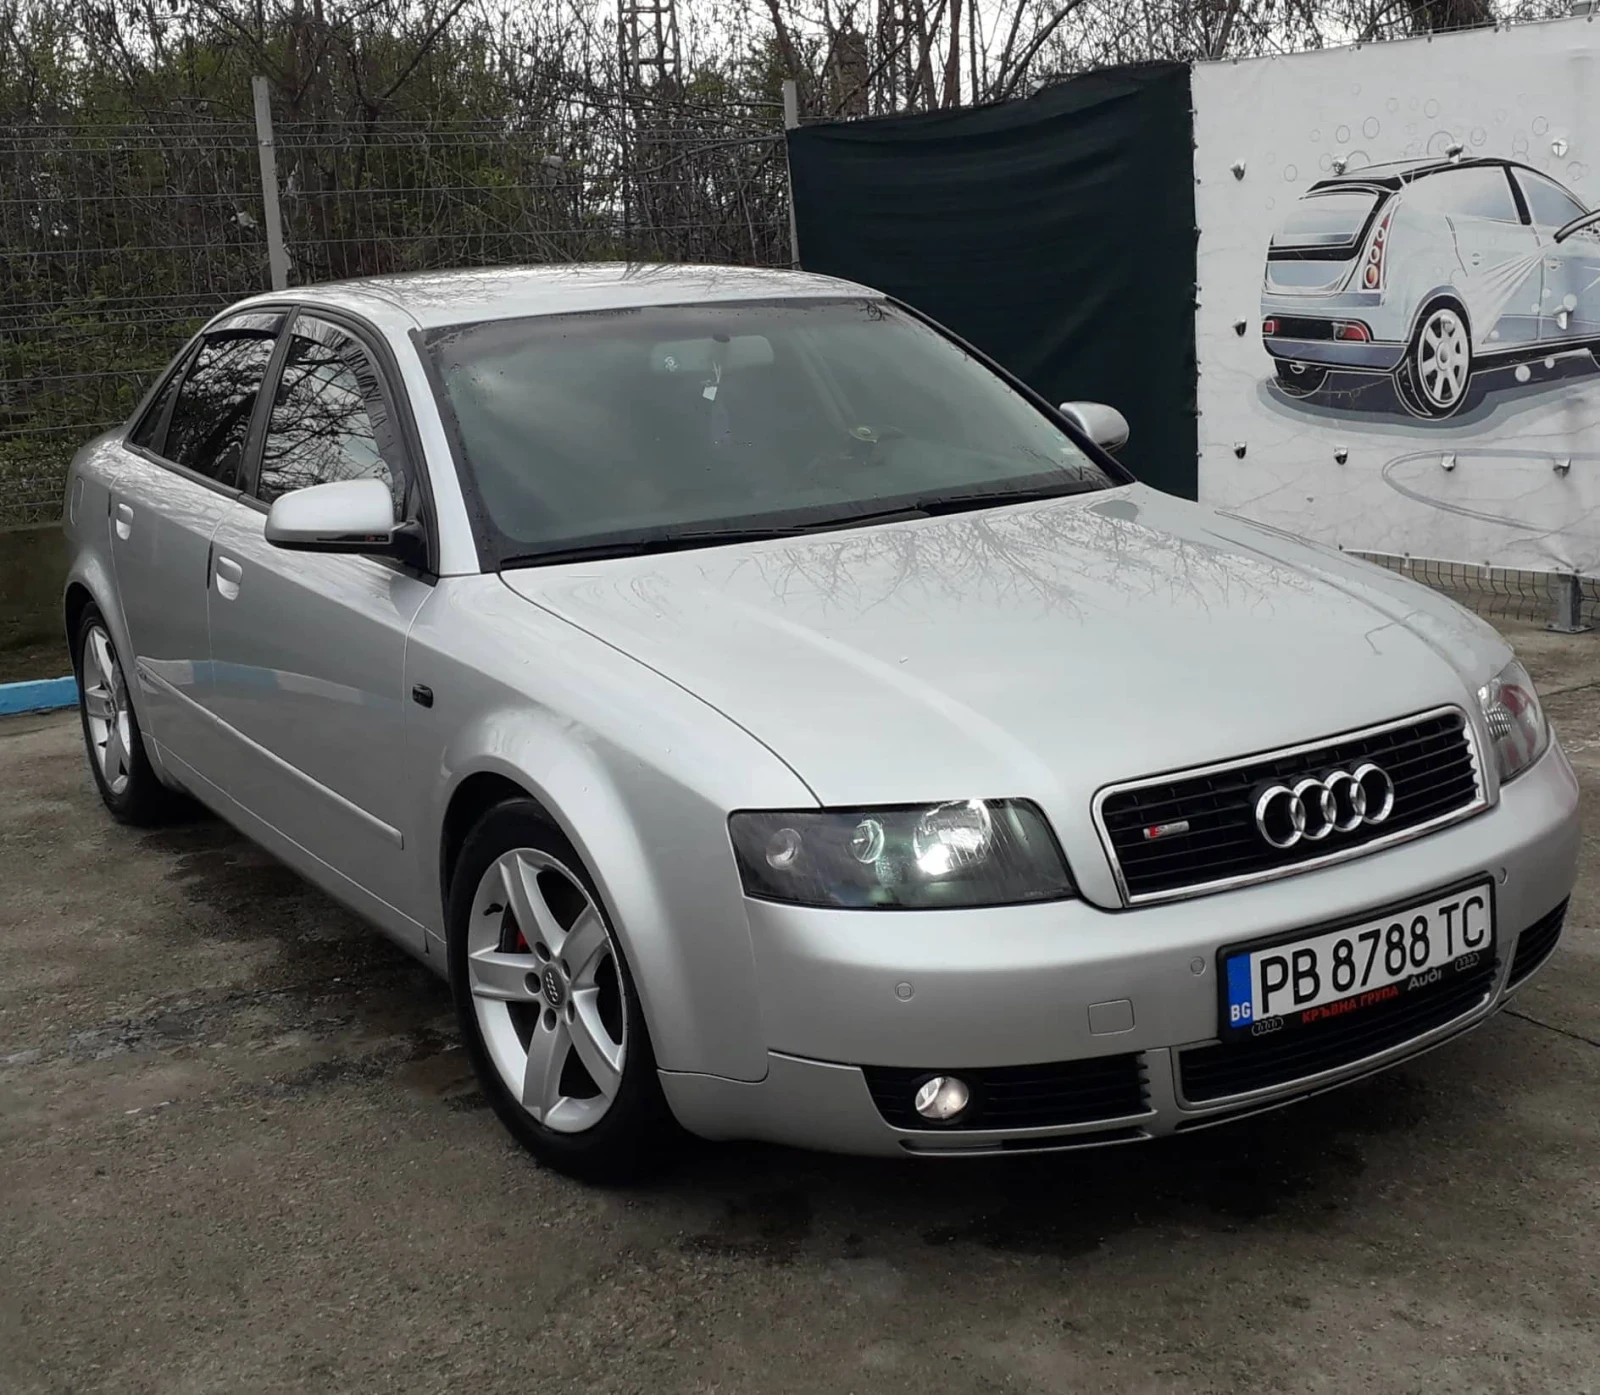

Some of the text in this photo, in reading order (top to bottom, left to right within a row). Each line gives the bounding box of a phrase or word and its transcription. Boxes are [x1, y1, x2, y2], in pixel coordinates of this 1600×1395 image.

[1260, 896, 1485, 1014] PB 8788 TC
[1408, 968, 1442, 990] Audi
[1231, 1002, 1251, 1022] BG
[1302, 985, 1399, 1023] КРЪВНА ГРУПА
